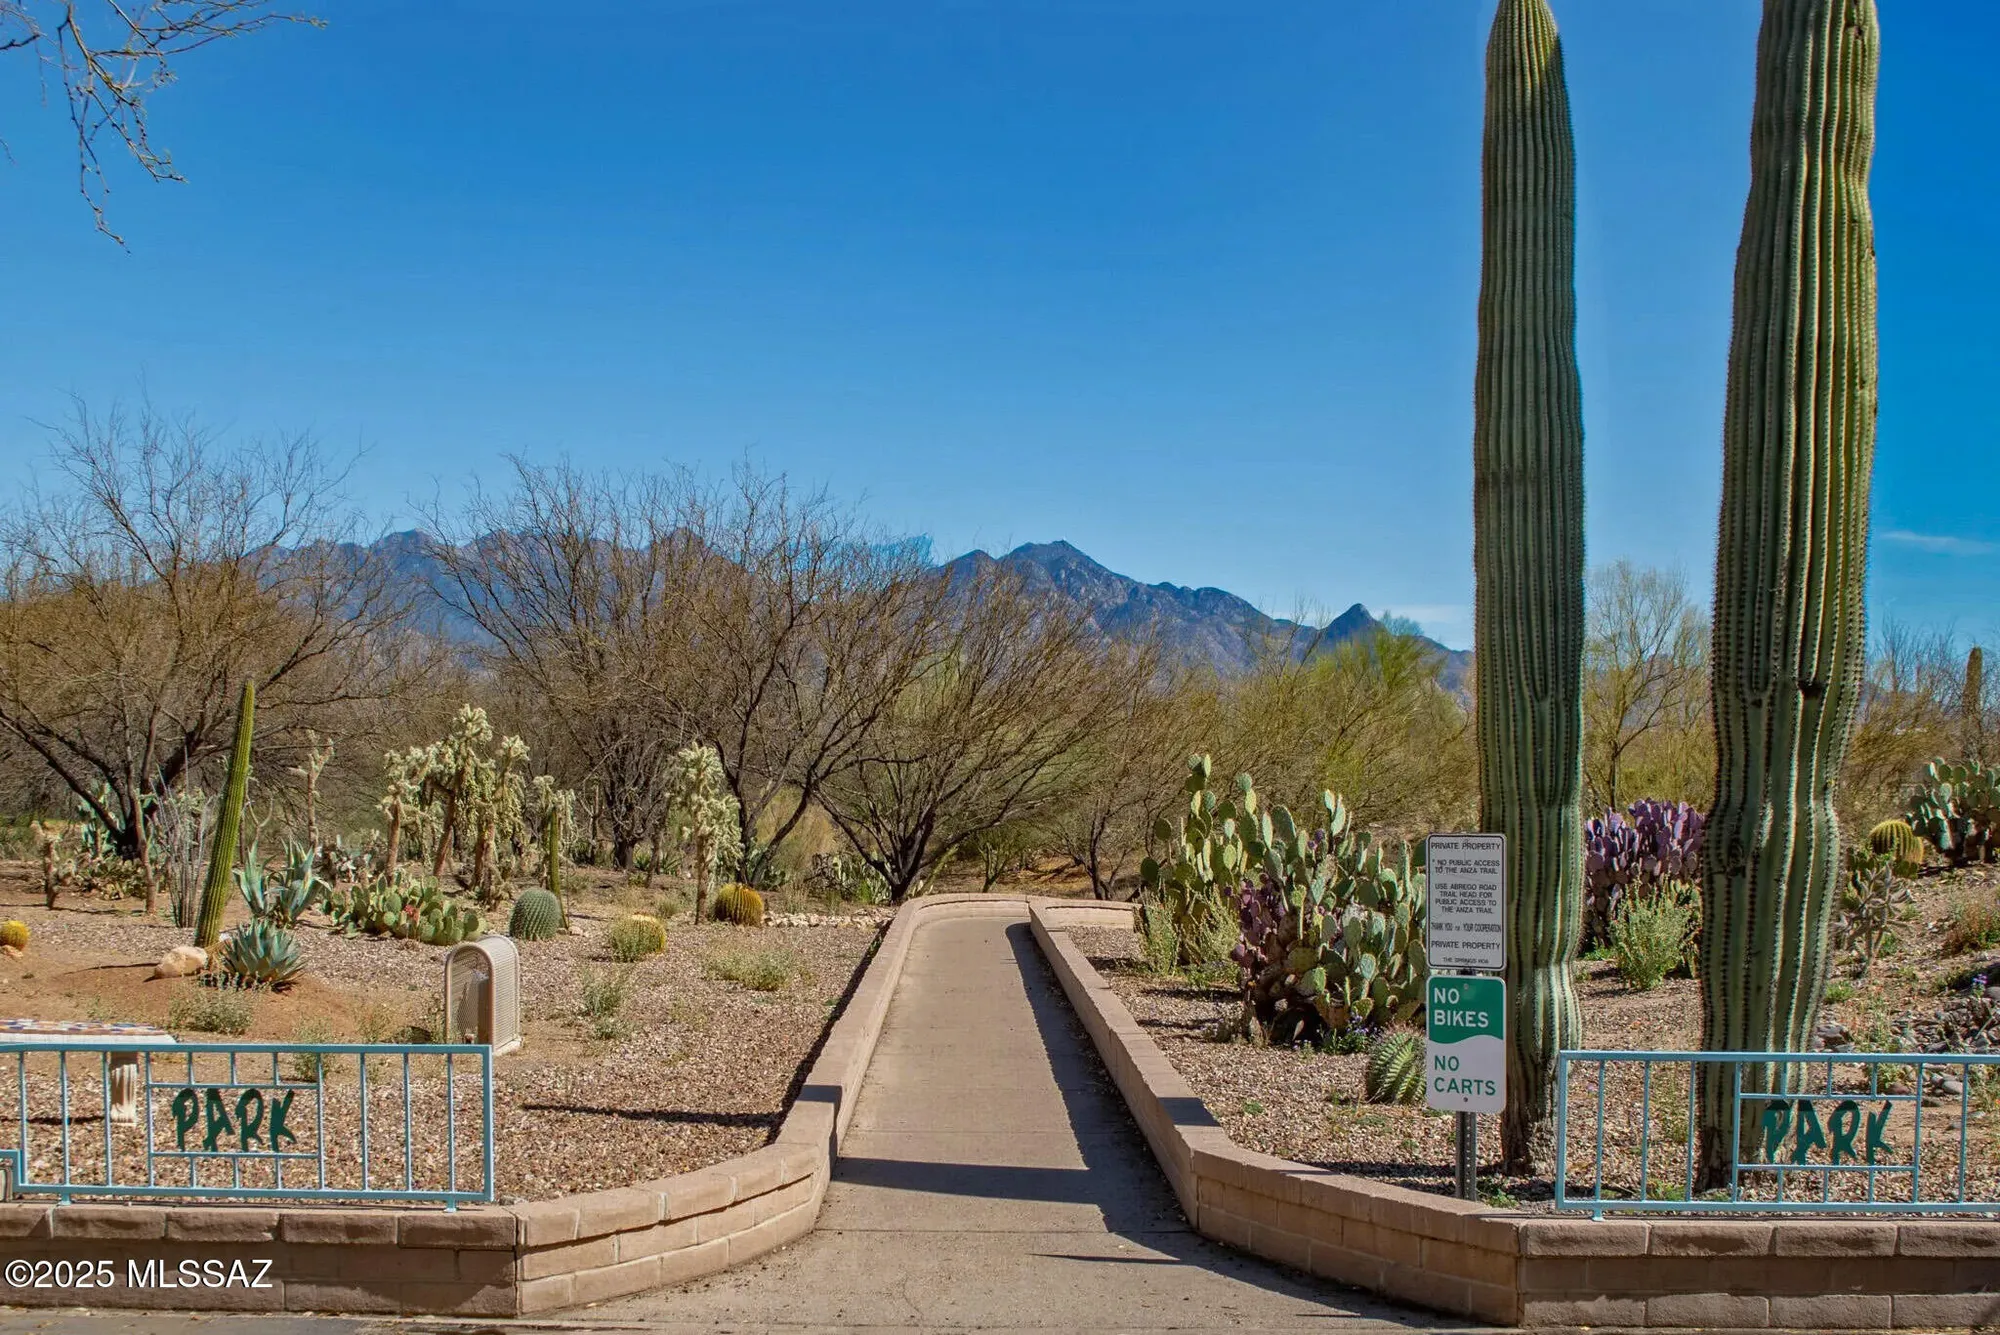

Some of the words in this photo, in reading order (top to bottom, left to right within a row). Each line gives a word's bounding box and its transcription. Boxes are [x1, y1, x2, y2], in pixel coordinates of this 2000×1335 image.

[1431, 941, 1459, 949] PRIVATE
[1462, 942, 1501, 950] PROPERTY
[1434, 987, 1460, 1005] NO
[1434, 1009, 1489, 1028] BIKES
[1434, 1055, 1460, 1072] NO
[1434, 1077, 1496, 1096] CARTS
[171, 1088, 298, 1152] PARK
[1761, 1099, 1893, 1166] PARK
